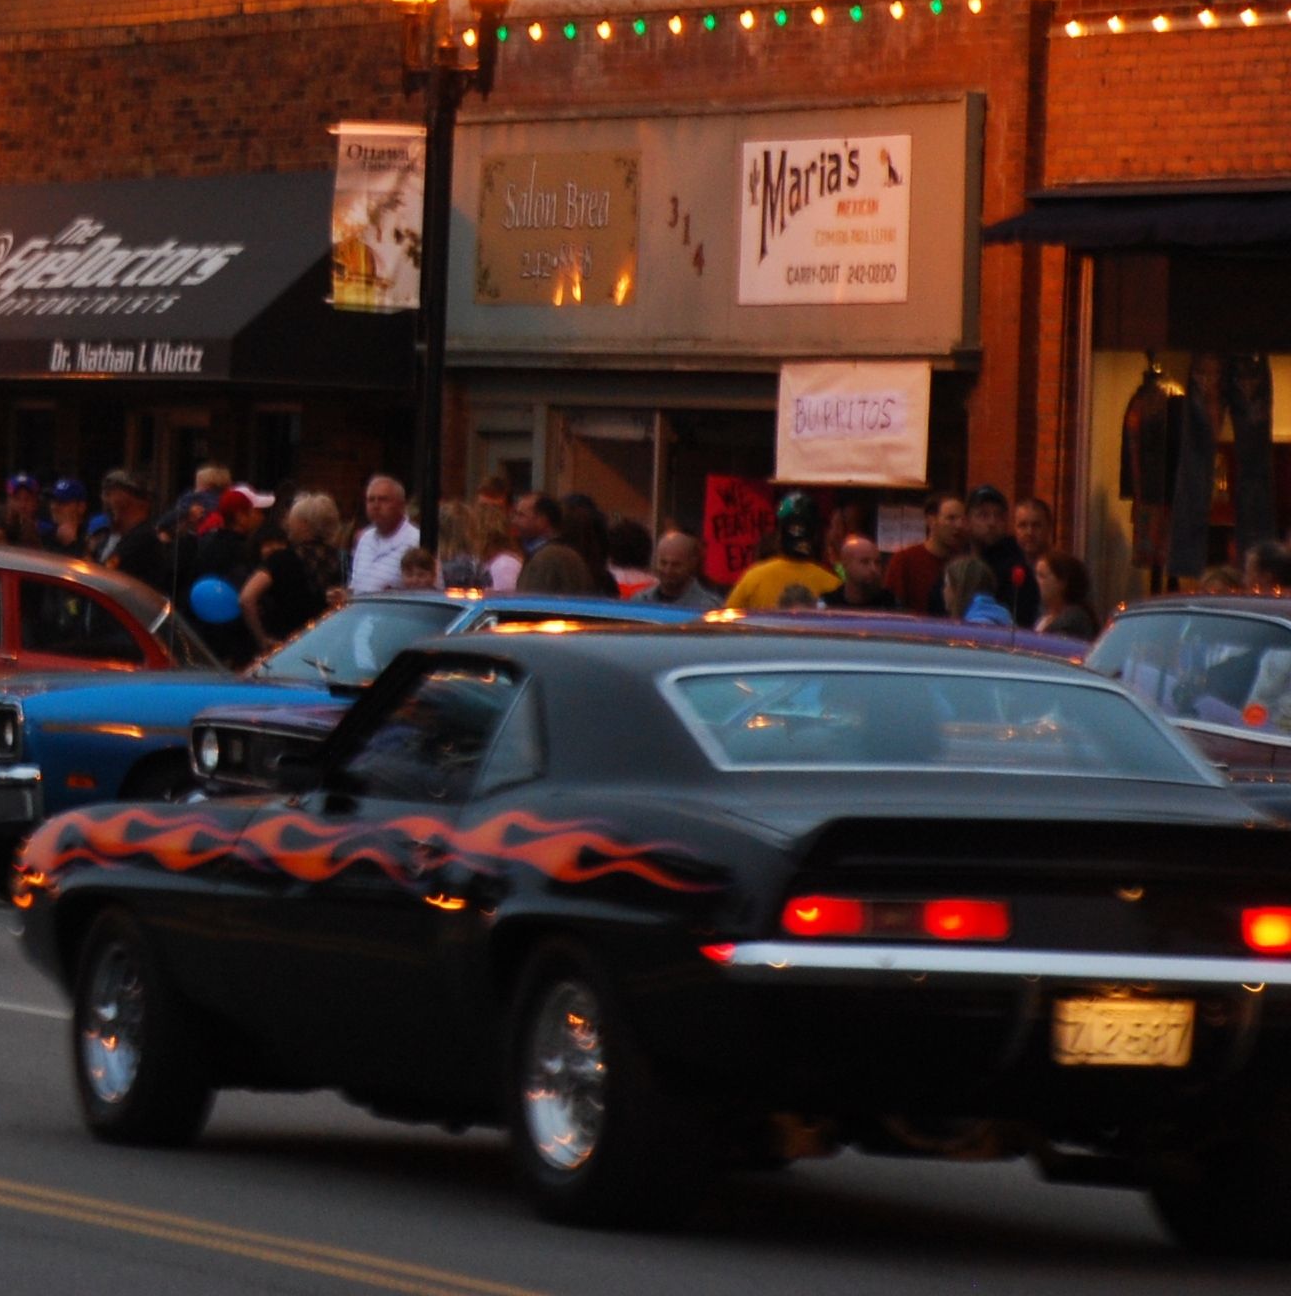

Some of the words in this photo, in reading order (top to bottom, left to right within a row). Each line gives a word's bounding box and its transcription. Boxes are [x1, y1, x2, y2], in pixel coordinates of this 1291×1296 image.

[502, 160, 557, 230] Salon
[564, 180, 611, 230] Brea
[757, 140, 861, 267] Maria's
[54, 216, 106, 246] The
[787, 264, 840, 286] CARRY-OUT
[49, 341, 72, 373] Dr.
[76, 341, 134, 373] Nathan
[138, 341, 148, 373] L
[151, 341, 203, 373] Kluttz
[794, 398, 897, 435] BURRITOS
